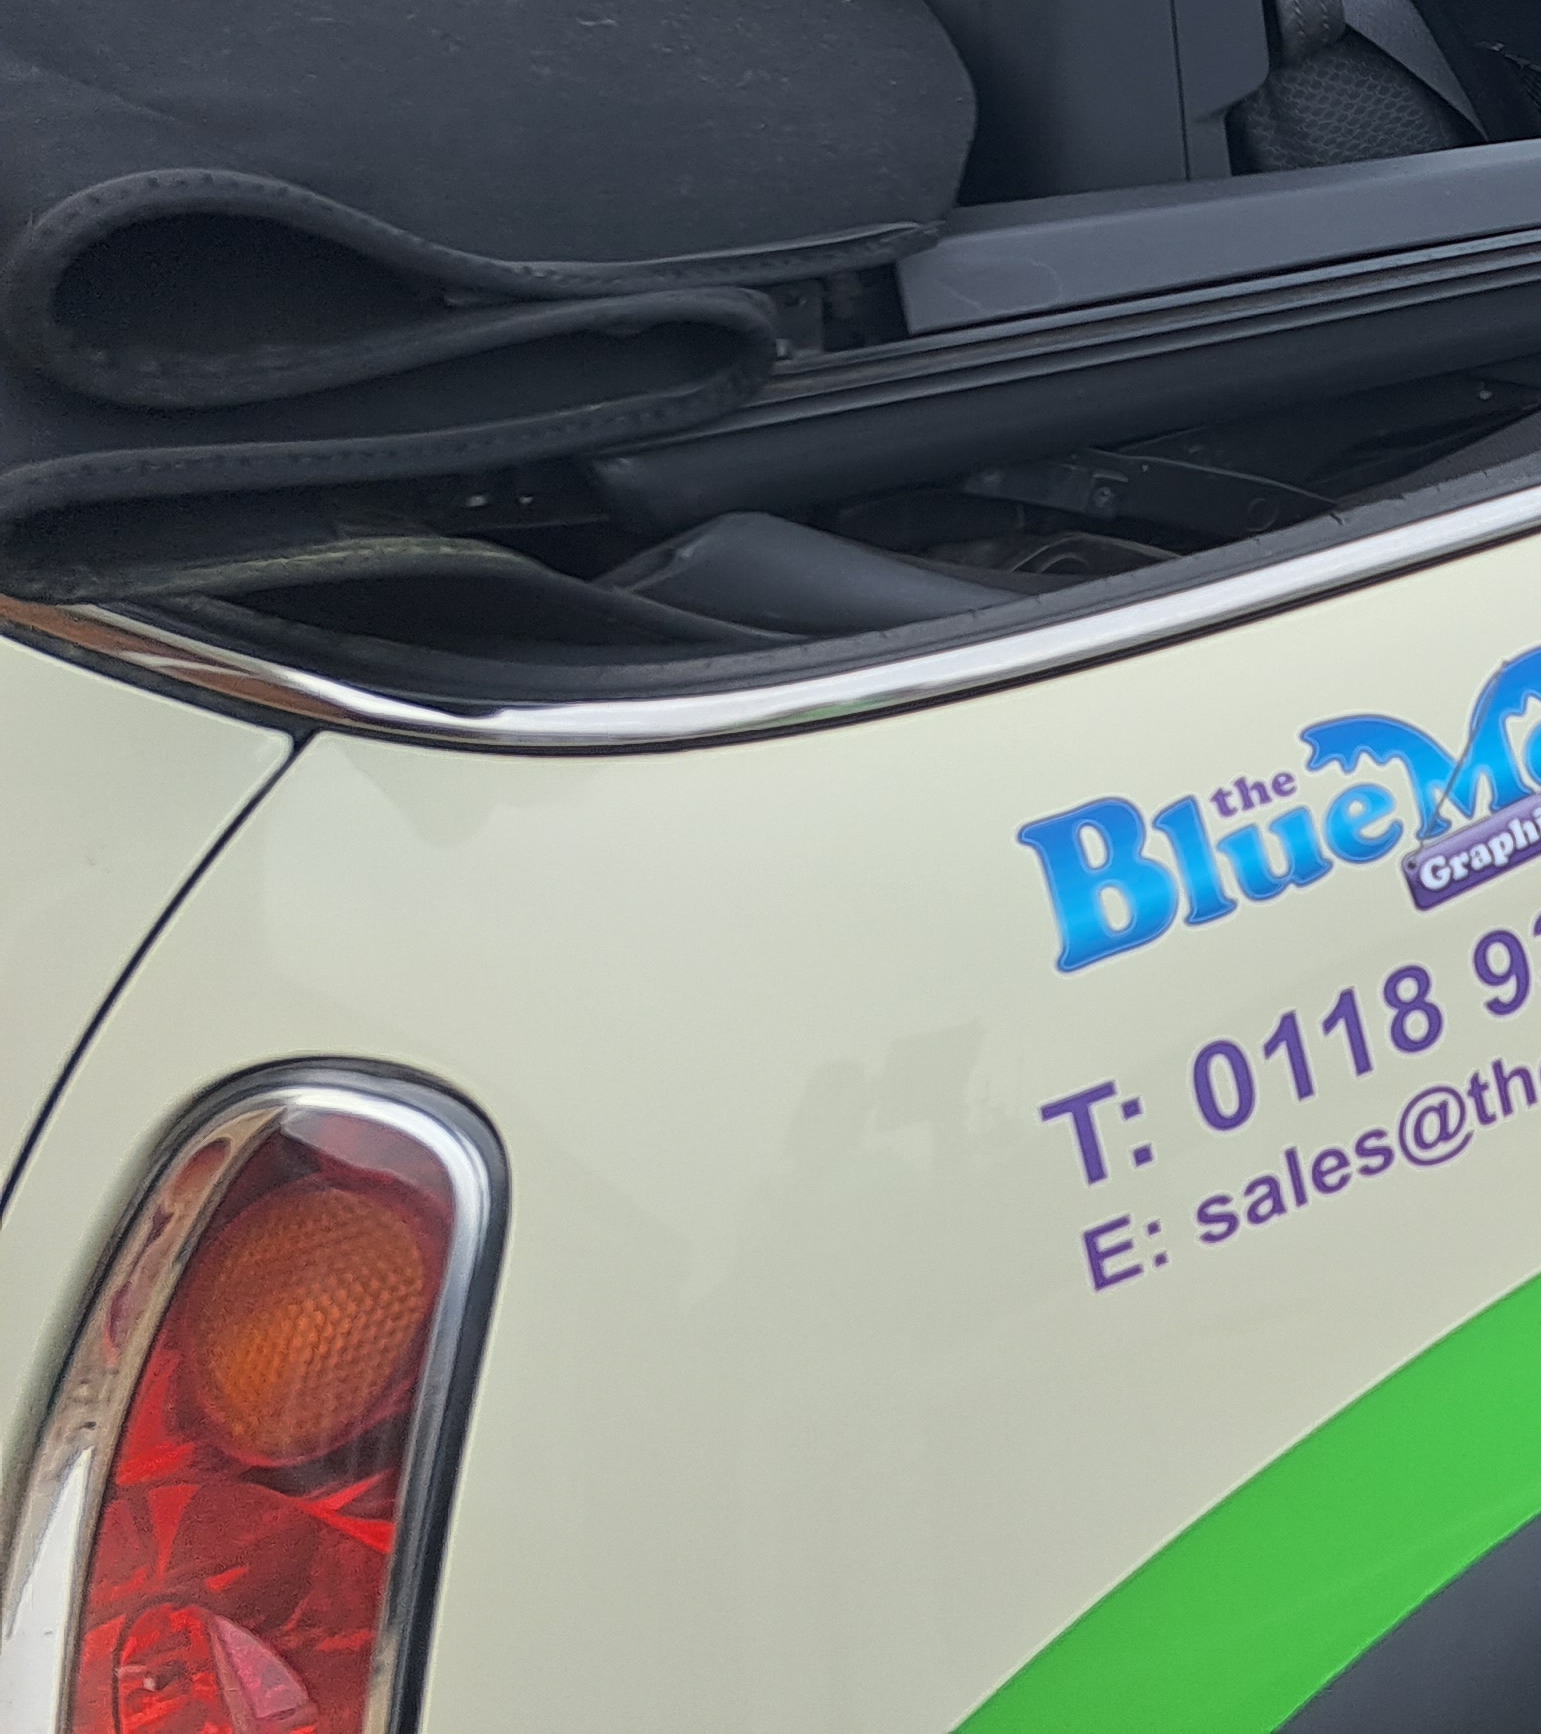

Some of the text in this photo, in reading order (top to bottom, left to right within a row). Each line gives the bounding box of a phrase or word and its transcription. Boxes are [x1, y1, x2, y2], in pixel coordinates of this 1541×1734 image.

[1211, 762, 1297, 820] the
[1040, 1084, 1155, 1188] T:
[1193, 964, 1444, 1135] 0118
[1081, 1217, 1168, 1292] E:
